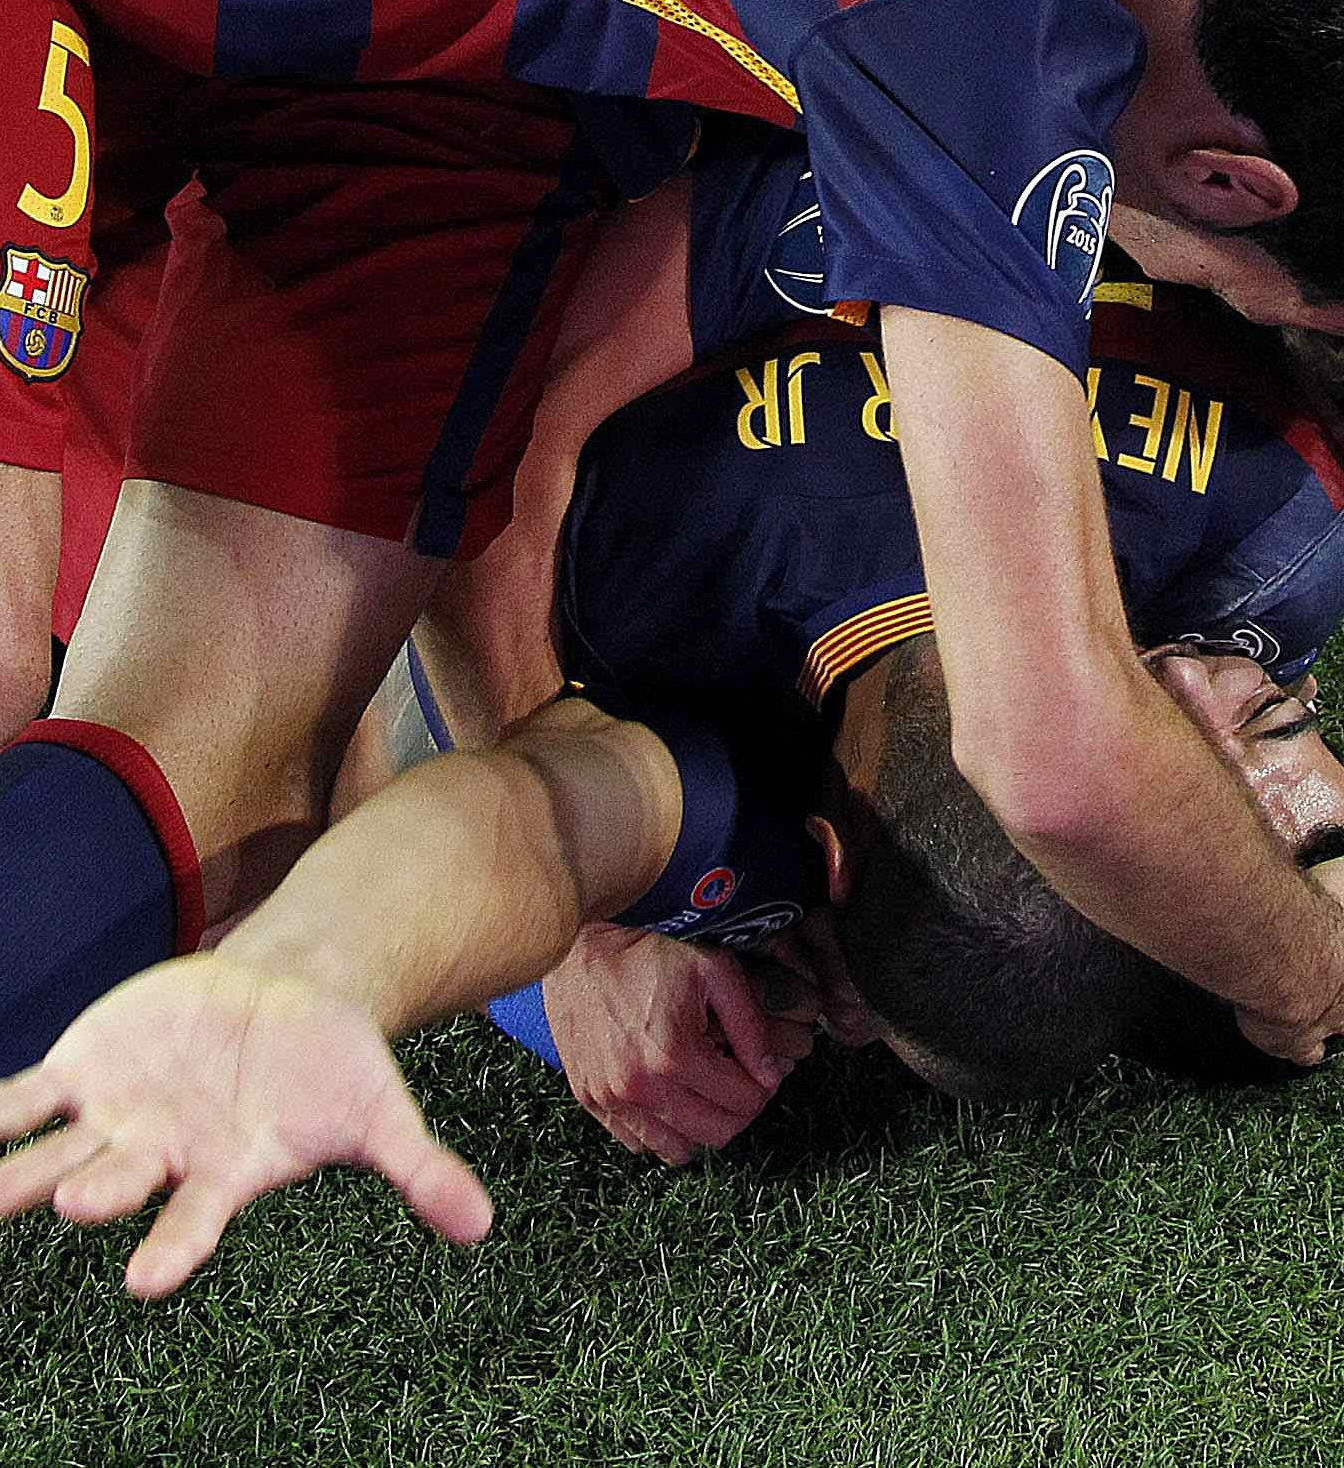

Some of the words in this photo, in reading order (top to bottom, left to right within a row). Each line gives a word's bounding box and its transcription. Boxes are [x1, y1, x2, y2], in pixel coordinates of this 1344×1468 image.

[16, 19, 91, 228] 5
[1066, 224, 1096, 255] 2015
[24, 302, 58, 324] FCB
[735, 352, 821, 450] JR
